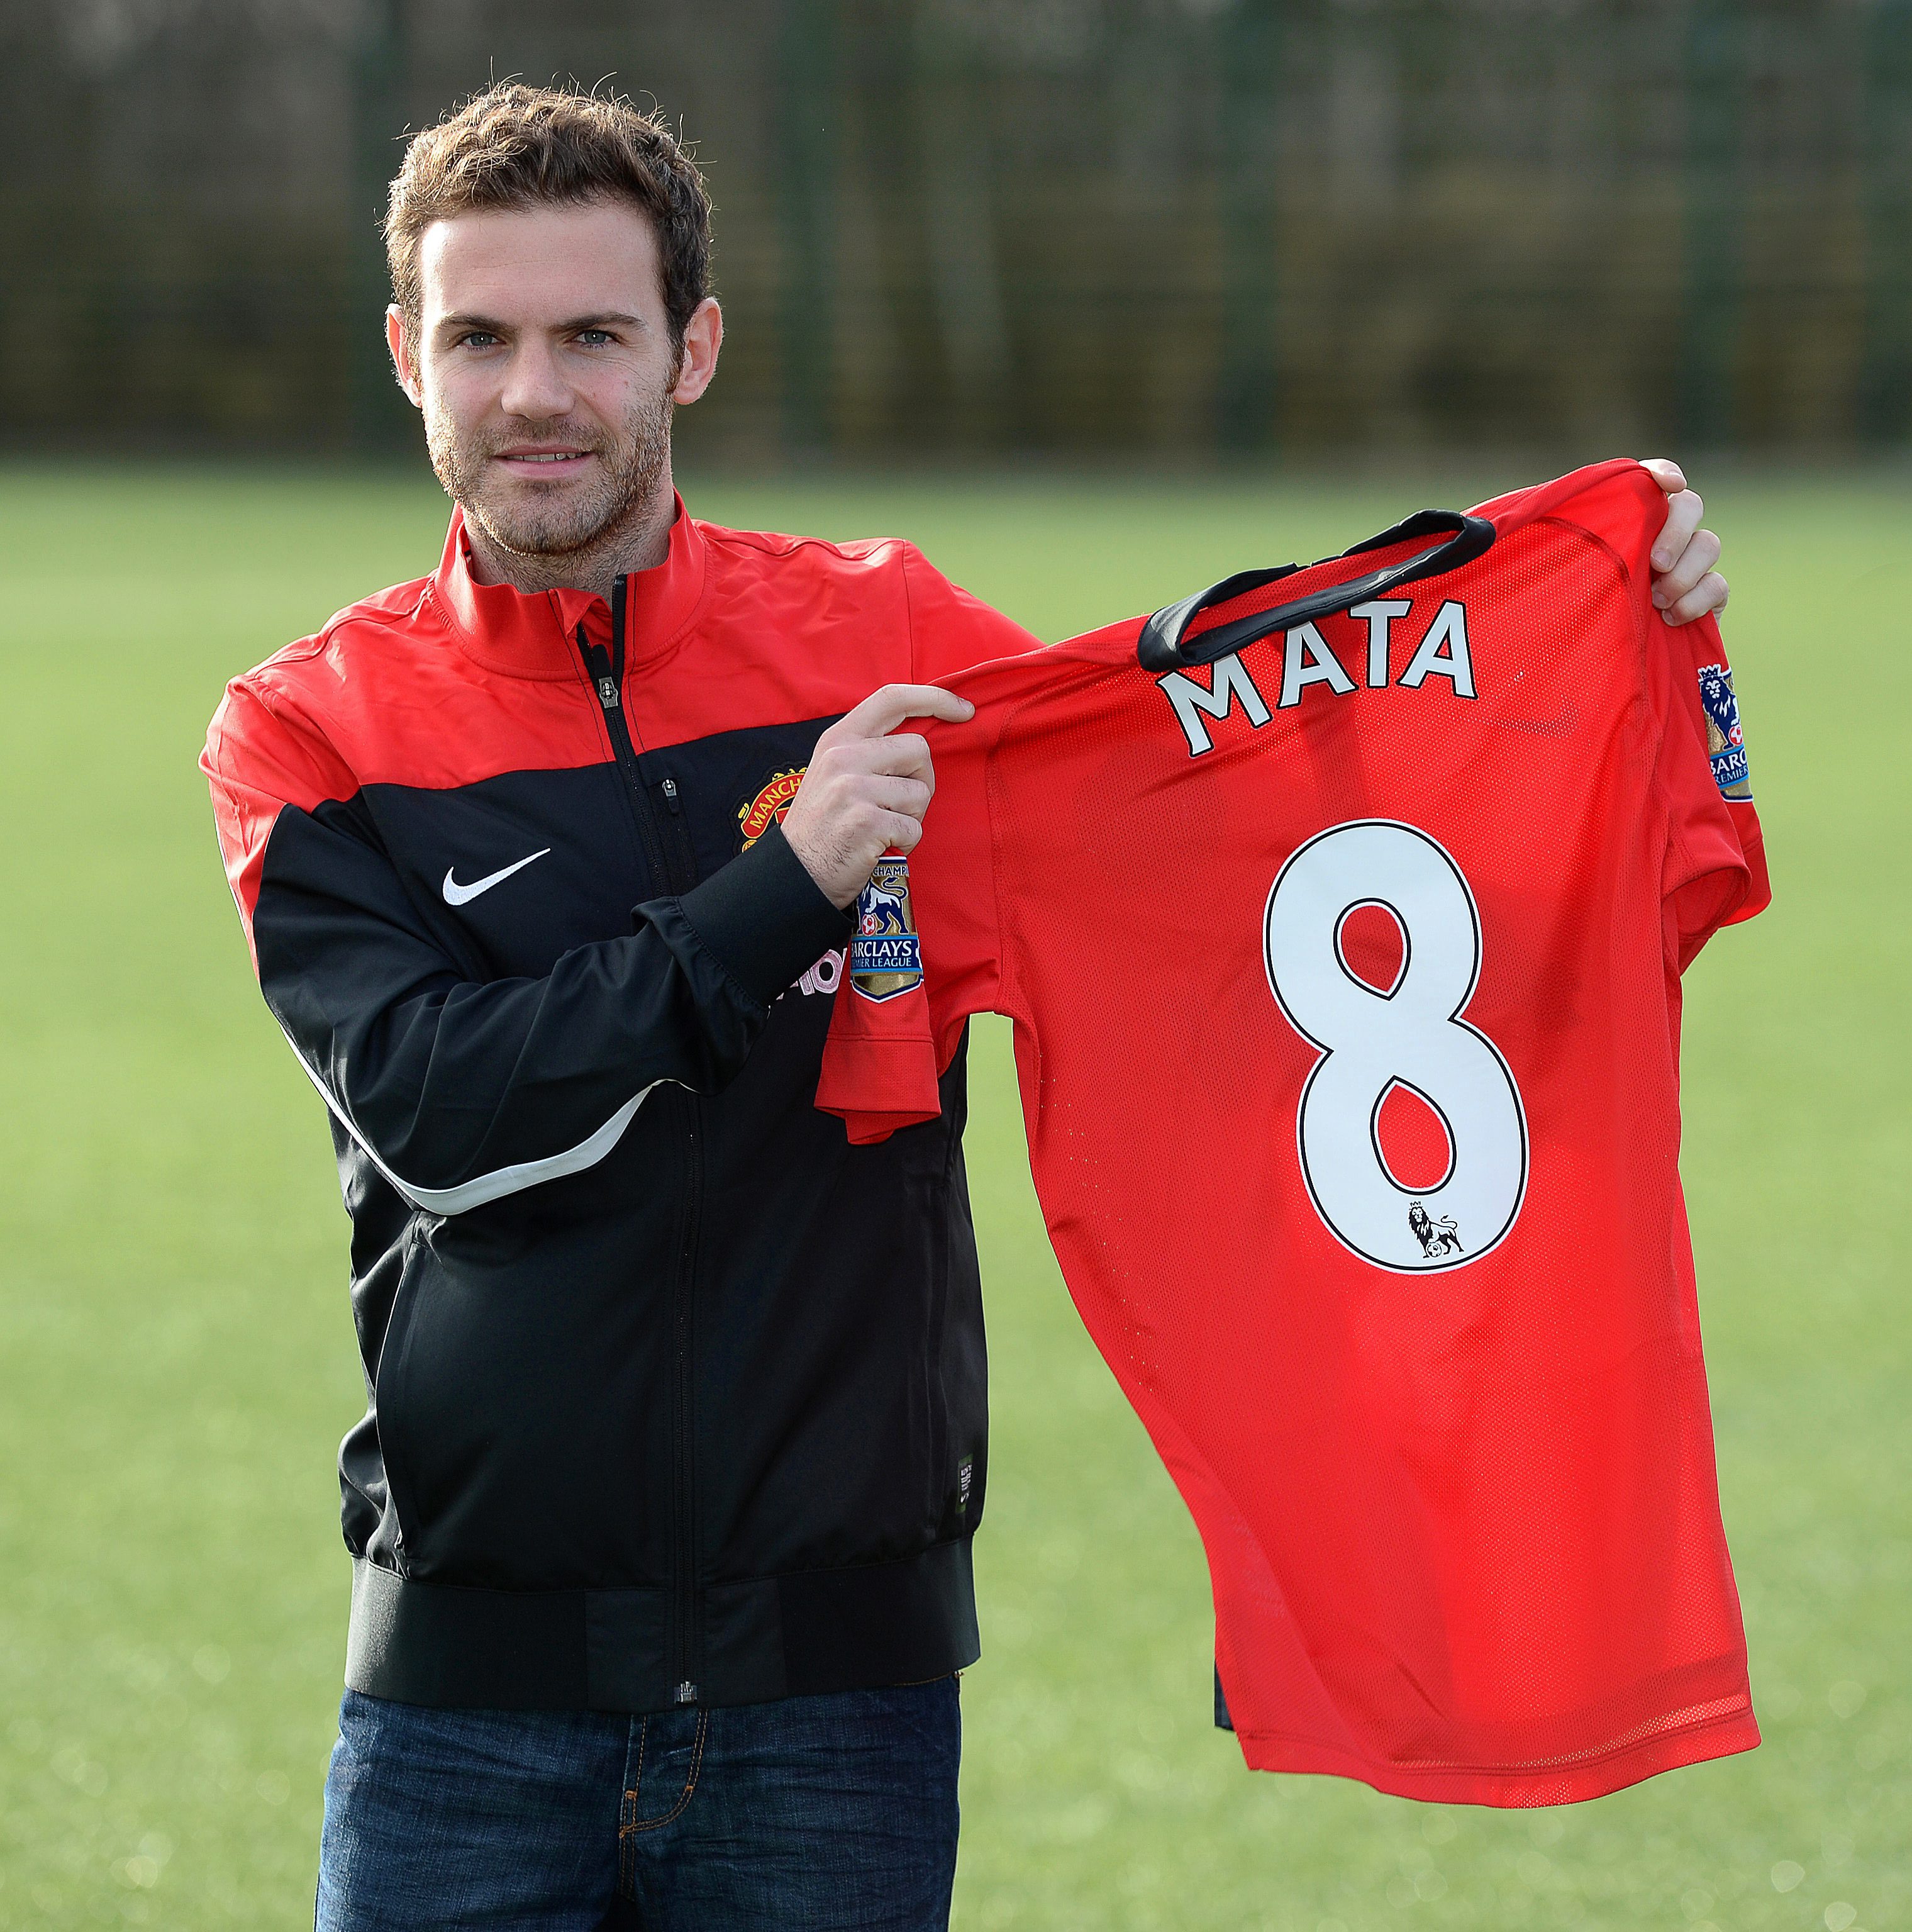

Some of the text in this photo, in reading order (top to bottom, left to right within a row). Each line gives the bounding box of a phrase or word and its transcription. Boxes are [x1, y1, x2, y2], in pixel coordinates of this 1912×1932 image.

[1155, 598, 1479, 759] MATA
[872, 957, 912, 967] LEAGUE
[1263, 818, 1530, 1275] 8
